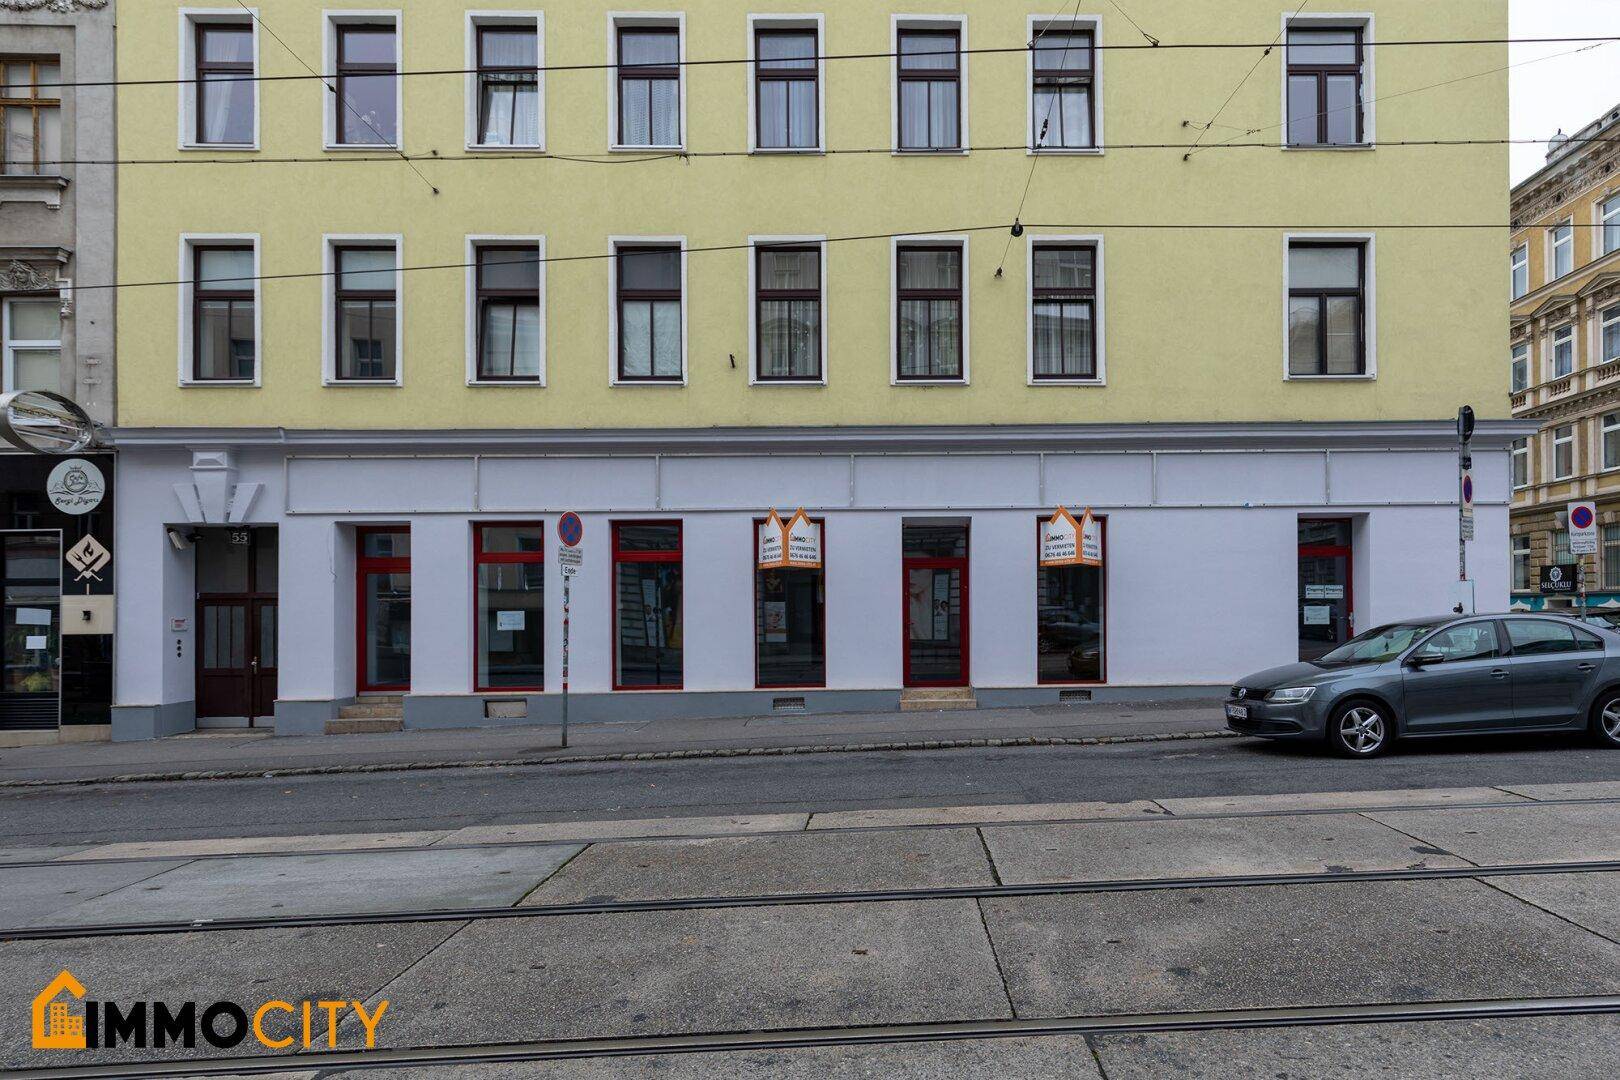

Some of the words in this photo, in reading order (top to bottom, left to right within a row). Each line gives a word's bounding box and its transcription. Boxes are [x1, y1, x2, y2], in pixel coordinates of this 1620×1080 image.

[231, 532, 248, 542] 55
[565, 566, 576, 575] Ende
[1541, 581, 1571, 590] SELÇUKLU
